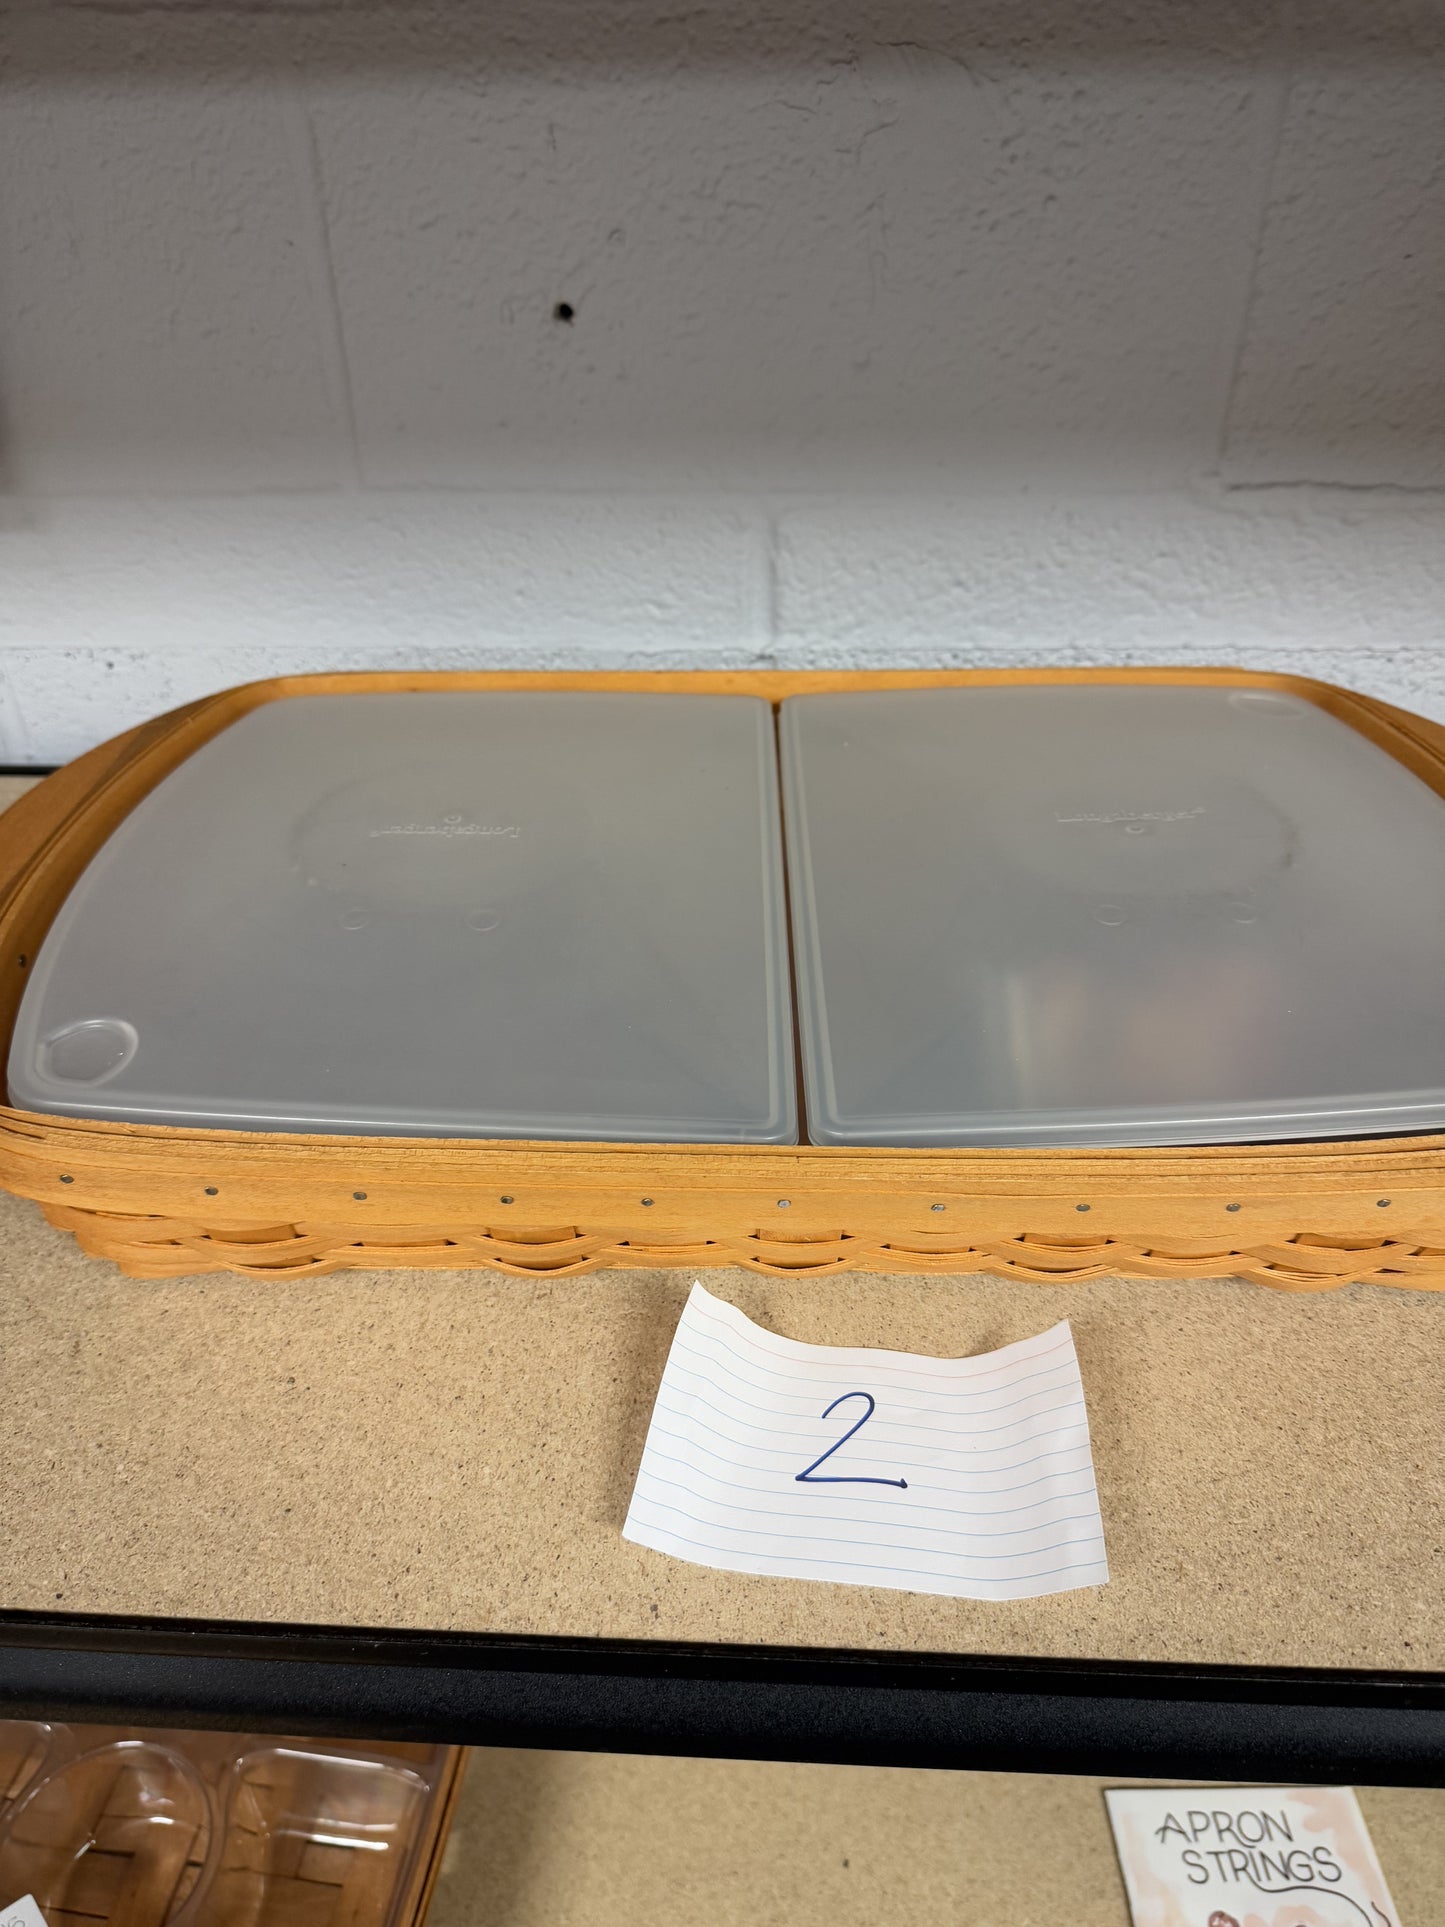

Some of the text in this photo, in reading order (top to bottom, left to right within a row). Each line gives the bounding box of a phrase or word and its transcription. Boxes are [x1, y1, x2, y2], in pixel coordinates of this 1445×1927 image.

[795, 1391, 908, 1488] 2
[1154, 1810, 1294, 1848] APRON
[1181, 1845, 1343, 1885] STRINGS
